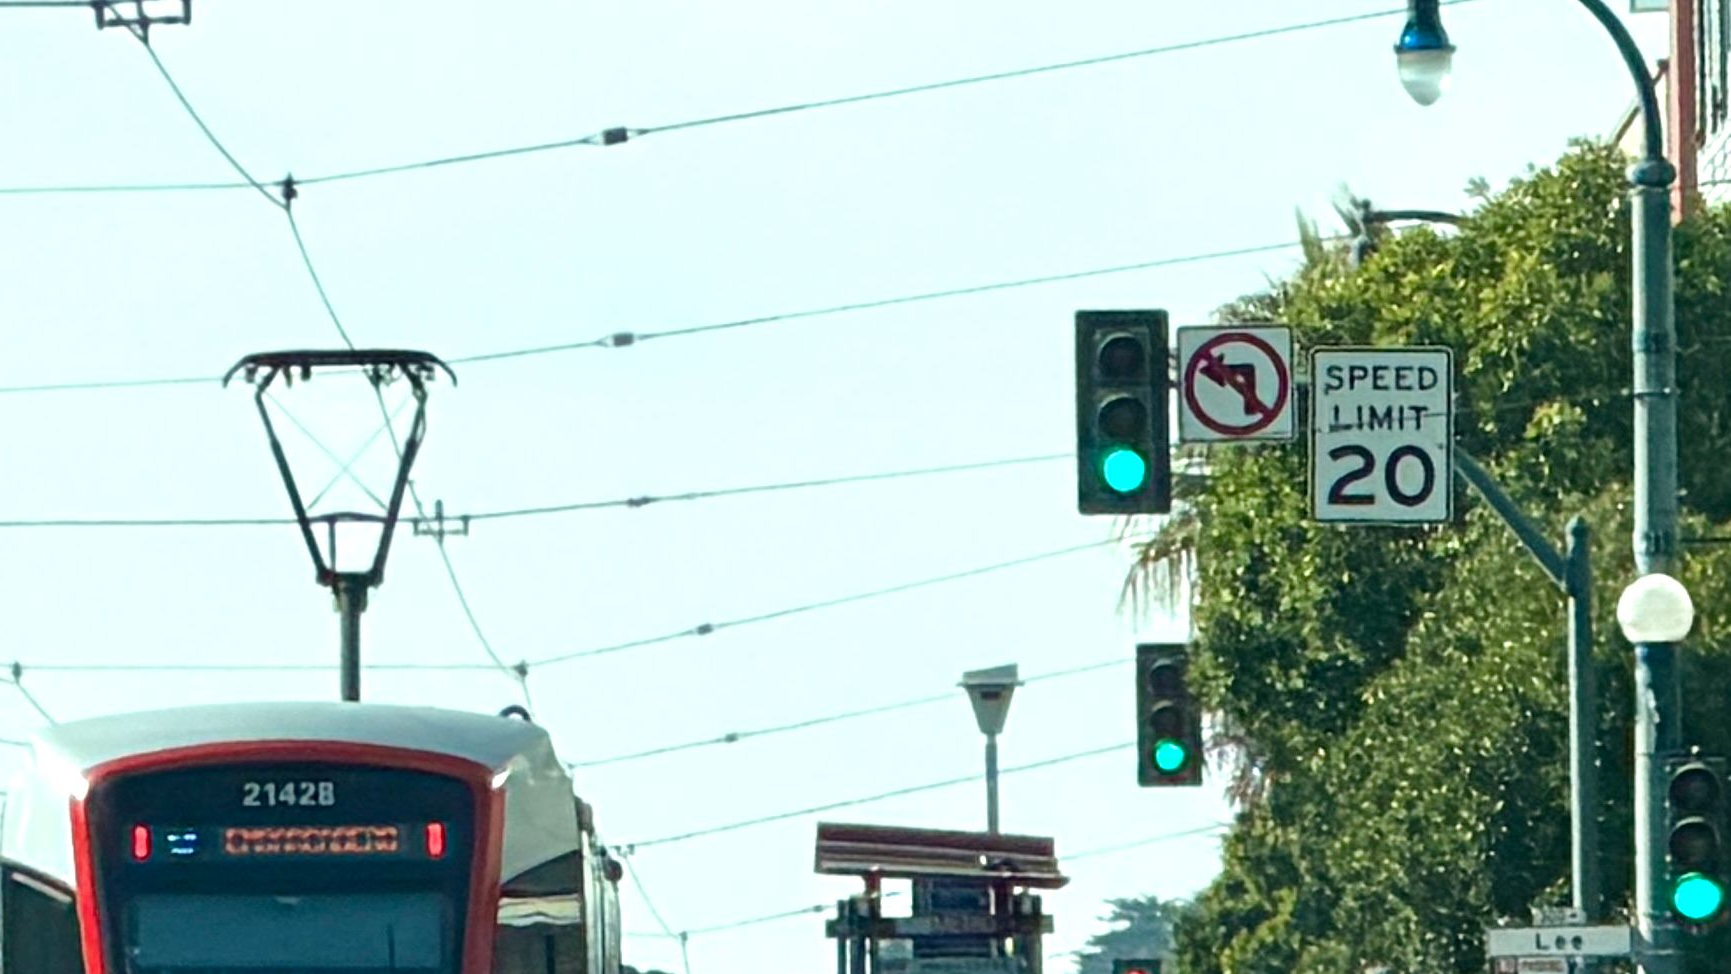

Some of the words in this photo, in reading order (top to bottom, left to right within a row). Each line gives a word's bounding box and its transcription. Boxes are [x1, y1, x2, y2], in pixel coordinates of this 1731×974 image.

[1325, 364, 1438, 391] SPEED
[1329, 404, 1429, 432] LIMIT
[1327, 444, 1436, 507] 20
[1534, 932, 1583, 951] Lee
